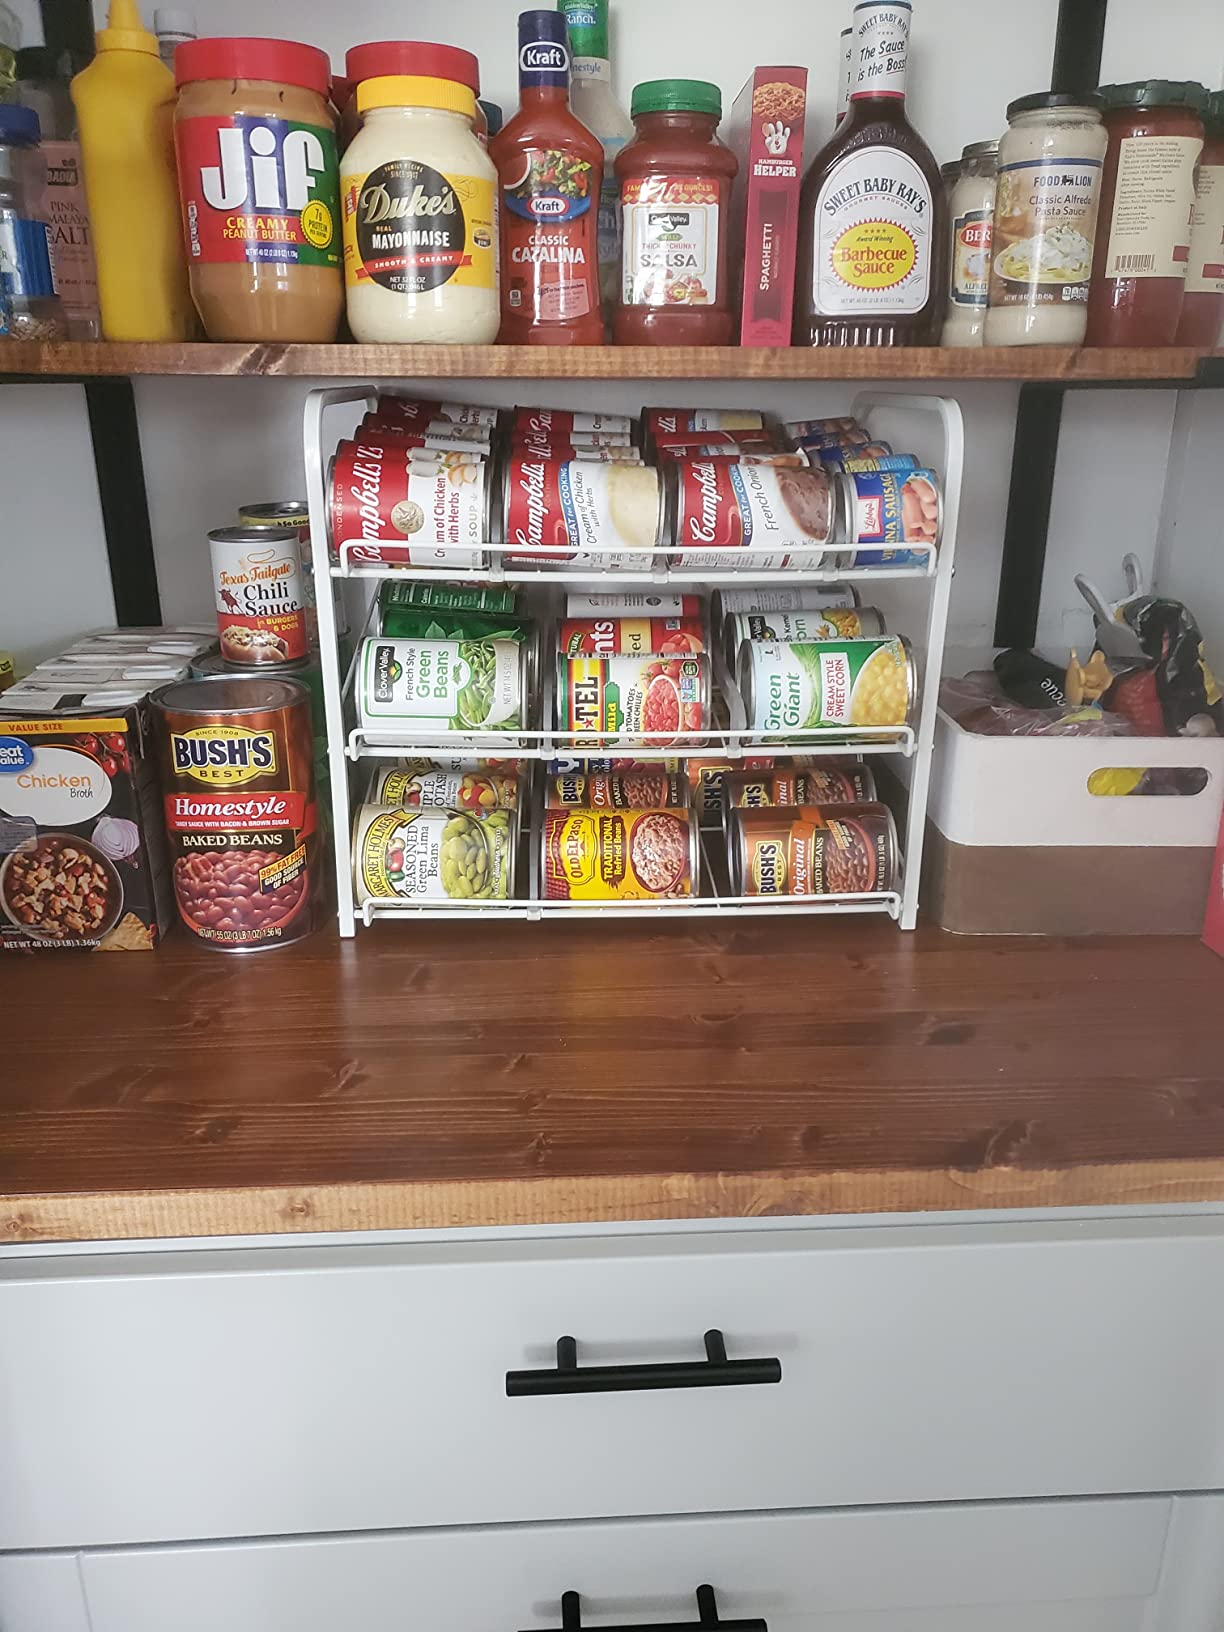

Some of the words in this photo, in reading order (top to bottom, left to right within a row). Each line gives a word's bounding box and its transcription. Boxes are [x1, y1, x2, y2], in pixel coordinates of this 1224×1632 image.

[859, 16, 878, 38] SWEET
[879, 13, 898, 22] BABY
[526, 49, 562, 66] Kraft
[860, 46, 876, 62] The
[878, 40, 904, 54] Sauce
[572, 62, 601, 74] estyle
[858, 68, 864, 82] is
[868, 62, 884, 77] the
[200, 126, 326, 211] Jif
[753, 164, 796, 177] HELPER
[1034, 176, 1059, 187] FOOD
[1075, 175, 1092, 186] LION
[50, 200, 81, 212] PINK
[360, 182, 457, 224] Duke's
[535, 201, 560, 212] Kraft
[824, 178, 862, 216] SWEET
[864, 178, 897, 194] BABY
[896, 182, 928, 214] RAY'S
[1029, 194, 1062, 206] Classic
[226, 216, 289, 230] CREAMY
[1063, 206, 1086, 216] Sauce
[46, 226, 89, 245] SALT
[222, 228, 259, 240] PEANUT
[262, 229, 297, 241] BUTTER
[308, 220, 328, 232] PROTEIN
[372, 230, 450, 250] MAYONNAISE
[528, 235, 569, 245] CLASSIC
[374, 259, 407, 268] SMOOTH
[419, 255, 454, 264] CREAMY
[512, 248, 586, 264] CATALINA
[760, 223, 773, 292] SPAGHETTI
[840, 247, 907, 263] Barbecue
[853, 262, 895, 278] Sauce
[560, 466, 571, 506] COOKING
[574, 472, 585, 504] Chicken
[750, 466, 763, 491] Onion
[434, 477, 446, 516] Chicken
[448, 492, 460, 525] Herbs
[586, 487, 596, 508] Herbs
[690, 461, 723, 543] Campbell
[435, 518, 445, 527] of
[468, 506, 478, 538] SOUP
[590, 509, 600, 527] with
[742, 505, 752, 536] GREAT
[756, 492, 780, 532] French
[569, 518, 580, 546] GREAT
[580, 513, 597, 544] Cream
[434, 527, 446, 558] Crm
[881, 521, 897, 561] VINA
[219, 571, 249, 586] Texas
[250, 562, 292, 583] Tailgate
[243, 582, 289, 600] Chili
[245, 600, 298, 617] Sauce
[266, 615, 298, 626] BURGERS
[281, 622, 298, 632] DOGS
[590, 621, 614, 654] nts
[380, 648, 392, 670] Valley
[406, 648, 416, 667] Style
[416, 650, 432, 698] Green
[434, 650, 450, 698] Beans
[826, 659, 834, 684] STYLE
[834, 658, 844, 686] CORN
[378, 670, 388, 698] Clover
[406, 668, 415, 701] French
[626, 688, 636, 727] TOMATOES
[634, 691, 643, 715] CHILIES
[764, 674, 782, 731] Green
[784, 672, 800, 728] Giant
[826, 685, 834, 717] CREAM
[834, 688, 844, 718] SWEET
[8, 724, 40, 732] VALUE
[606, 702, 617, 733] Mild
[0, 745, 24, 757] eat
[0, 756, 25, 765] alue
[174, 736, 273, 770] BUSH'S
[16, 774, 92, 789] Chicken
[200, 769, 246, 778] BEST
[70, 787, 94, 799] Broth
[434, 774, 448, 807] OTASH
[174, 796, 287, 820] Homestyle
[220, 820, 242, 828] BACON
[272, 818, 290, 826] SUGAR
[614, 822, 622, 844] Beans
[182, 836, 228, 846] BAKED
[228, 834, 283, 846] BEANS
[370, 816, 394, 856] HOLMES
[418, 826, 430, 856] Lima
[567, 840, 579, 856] EL
[277, 857, 290, 870] FAT
[290, 846, 306, 862] FREE
[406, 824, 419, 894] SEASONED
[428, 842, 439, 878] Beans
[603, 818, 613, 880] TRADITIONAL
[614, 844, 622, 876] Refried
[815, 836, 824, 868] BEANS
[264, 872, 282, 886] GOOD
[282, 856, 304, 876] SOURCE
[366, 854, 392, 898] MARGARET
[417, 860, 428, 894] Green
[570, 858, 583, 878] OLD
[760, 844, 777, 894] BUSH'S
[792, 838, 810, 895] Original
[273, 879, 282, 889] OF
[815, 869, 824, 894] BAKED
[4, 941, 18, 949] NET
[32, 940, 41, 948] 48
[42, 940, 52, 948] OZ
[216, 930, 223, 940] 55
